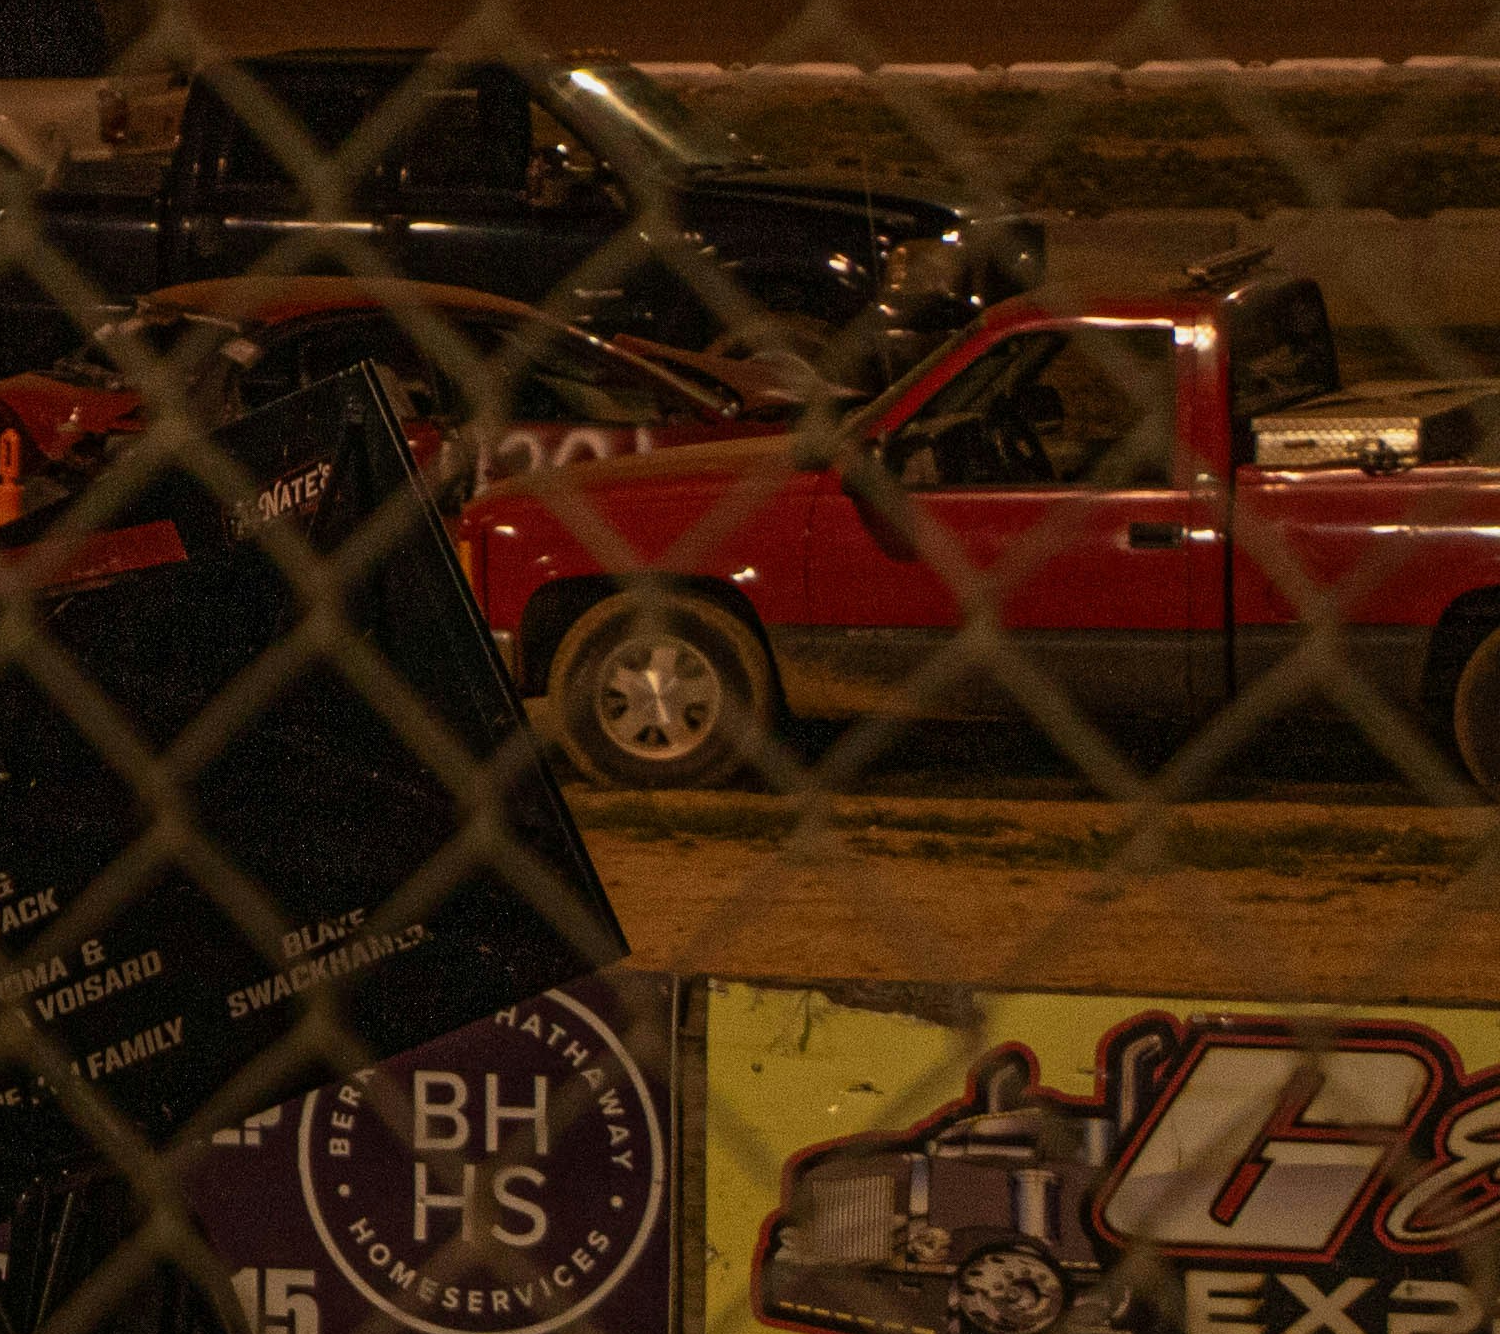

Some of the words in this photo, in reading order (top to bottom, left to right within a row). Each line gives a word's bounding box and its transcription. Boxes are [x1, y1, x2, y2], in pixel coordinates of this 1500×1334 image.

[413, 1070, 551, 1156] BH
[495, 1004, 637, 1171] HATHAWAY
[413, 1162, 549, 1247] HS
[348, 1216, 613, 1317] HOMESERVICES
